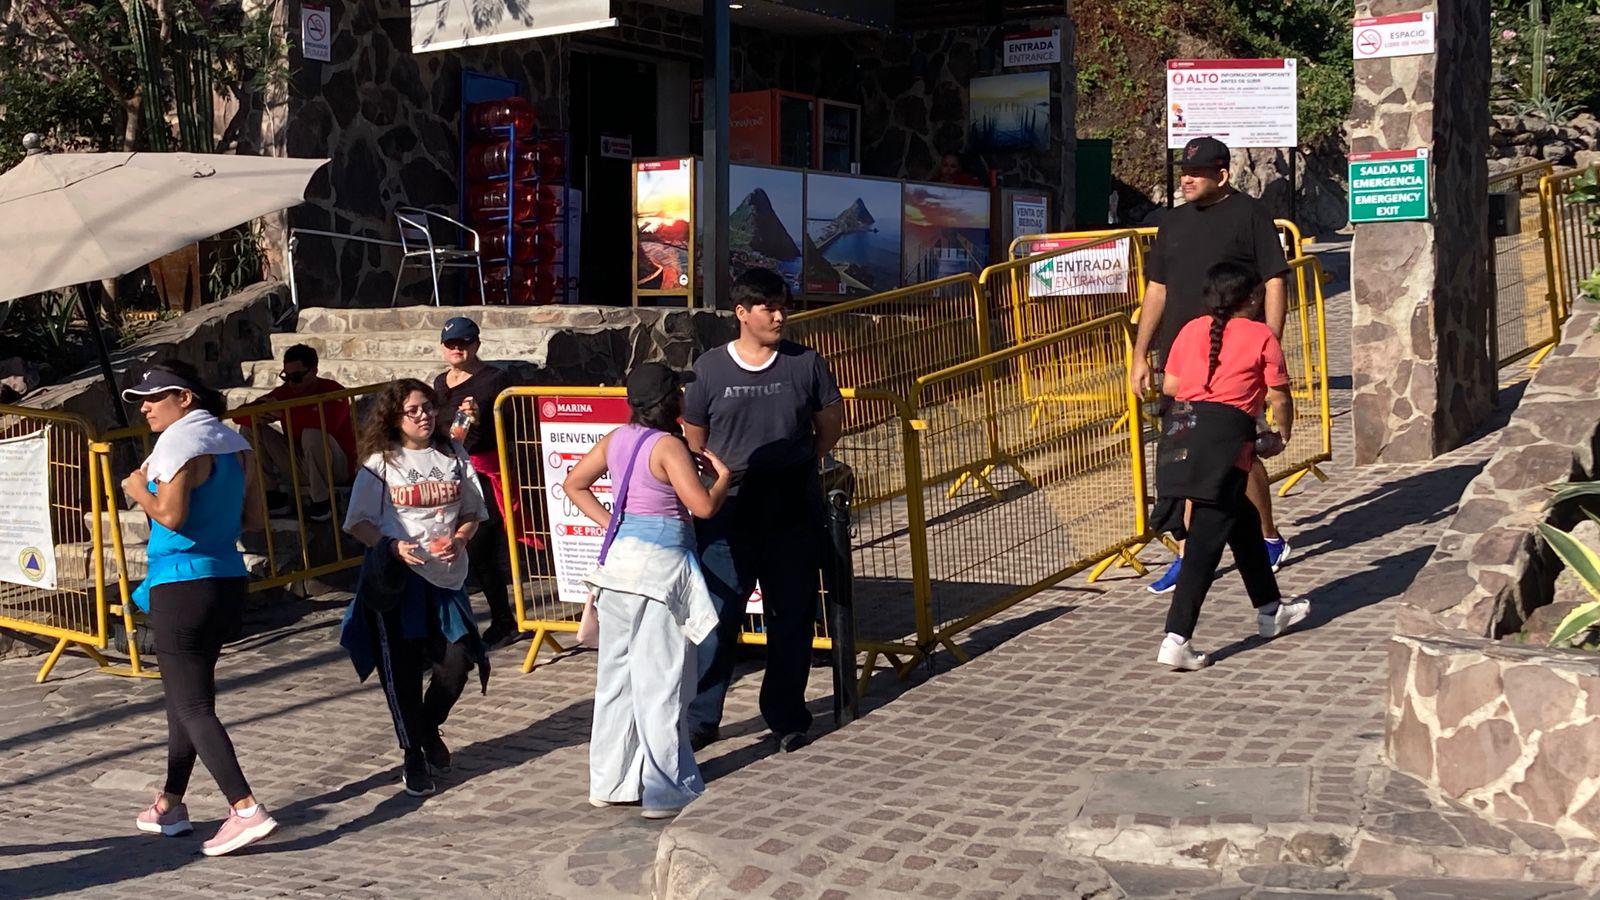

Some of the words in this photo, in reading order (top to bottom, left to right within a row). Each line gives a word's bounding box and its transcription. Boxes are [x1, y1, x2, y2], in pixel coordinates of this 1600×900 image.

[1390, 29, 1425, 40] ESPACIO
[1009, 40, 1054, 53] ENTRADA
[1009, 51, 1054, 64] ENTRANCE
[1186, 73, 1219, 84] ALTO
[1360, 164, 1398, 176] SALIDA
[1400, 163, 1415, 174] DE
[1353, 175, 1423, 189] EMERGENCIA
[1355, 192, 1421, 205] EMERGENCY
[1016, 207, 1035, 217] VENTA
[1036, 209, 1044, 218] DE
[1376, 205, 1400, 217] EXIT
[1018, 217, 1042, 228] BEBIDAS
[1056, 259, 1122, 273] ENTRADA
[1055, 273, 1124, 288] ENTRANCE
[557, 403, 593, 413] MARINA
[390, 486, 414, 506] HOT
[573, 526, 583, 535] SE
